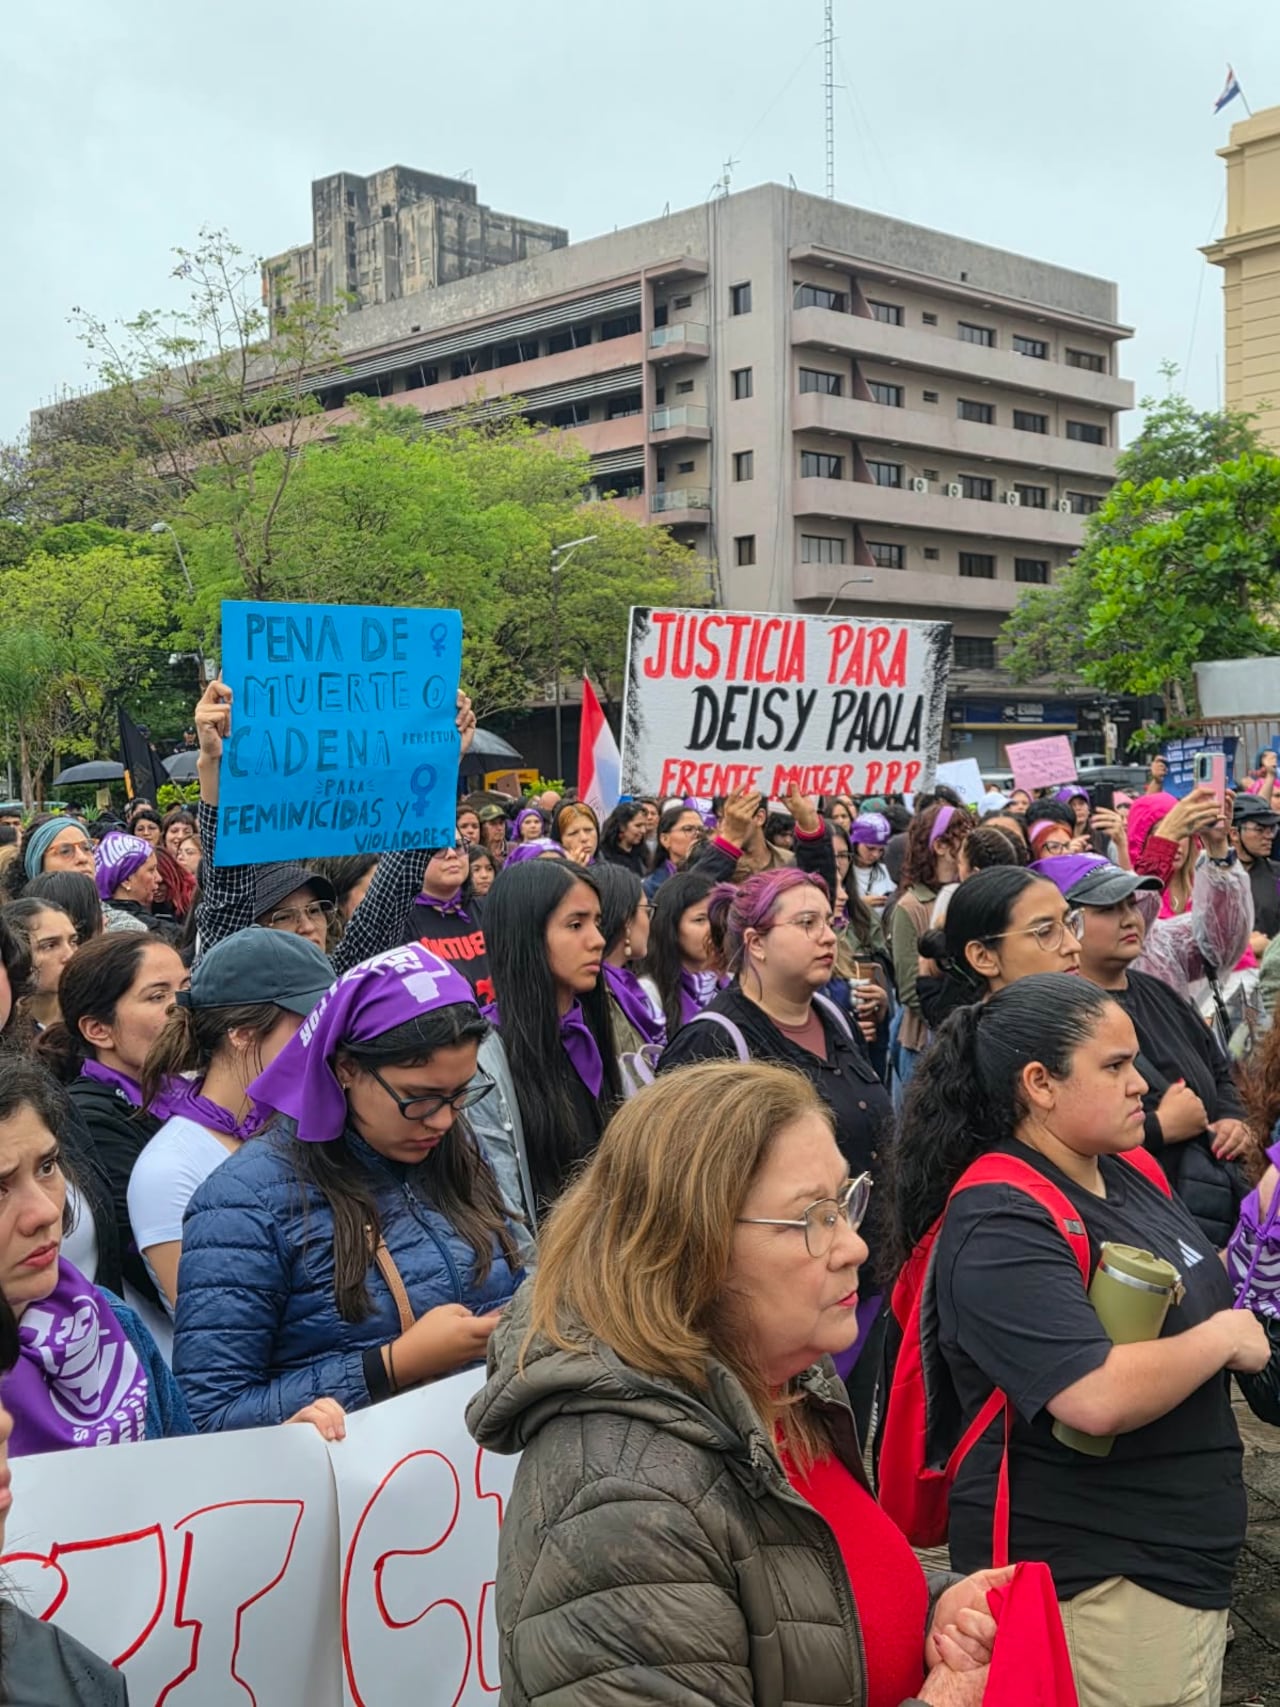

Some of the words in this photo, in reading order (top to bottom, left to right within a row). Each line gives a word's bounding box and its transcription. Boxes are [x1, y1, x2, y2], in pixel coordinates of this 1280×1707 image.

[246, 613, 344, 663] PENA
[361, 616, 409, 662] DE
[643, 612, 806, 683] JUSTICIA
[827, 624, 908, 688] PARA
[243, 671, 409, 718] MUERTE
[422, 674, 447, 710] O
[684, 684, 818, 752] DEISY
[825, 689, 925, 753] PAOLA
[228, 725, 391, 778] CADENA
[324, 778, 365, 797] PARA
[659, 758, 764, 798] FRENTE
[222, 798, 384, 837] FEMINICIDAS
[396, 801, 410, 830] Y
[354, 827, 452, 853] VIOLADORES
